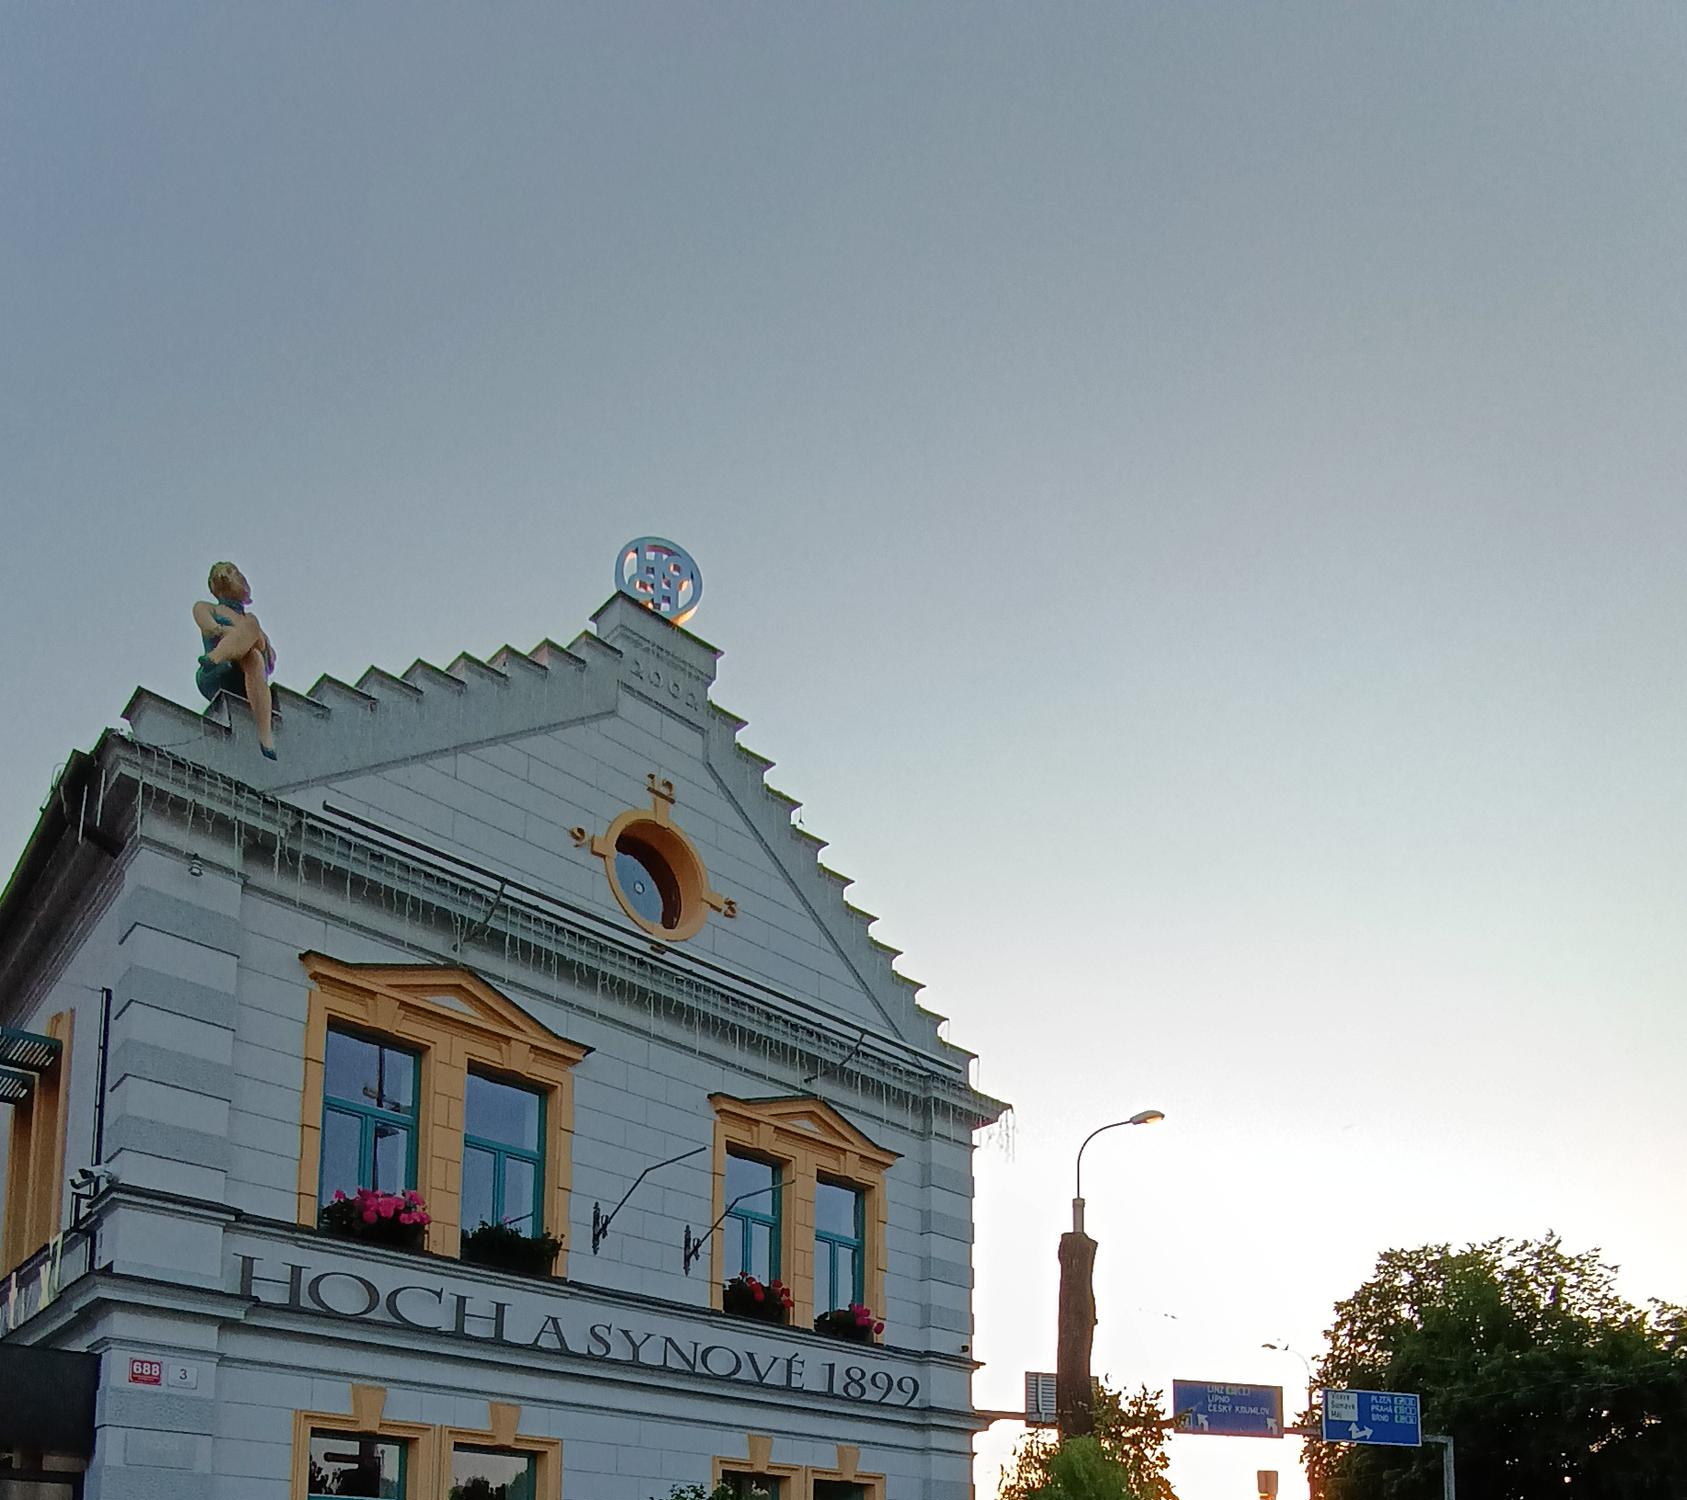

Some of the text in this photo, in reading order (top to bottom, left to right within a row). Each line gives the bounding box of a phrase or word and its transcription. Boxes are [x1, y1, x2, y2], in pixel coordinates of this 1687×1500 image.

[233, 1253, 920, 1406] HOCH A SYNOVÉ 1899
[133, 1362, 160, 1376] 688
[179, 1368, 187, 1380] 3
